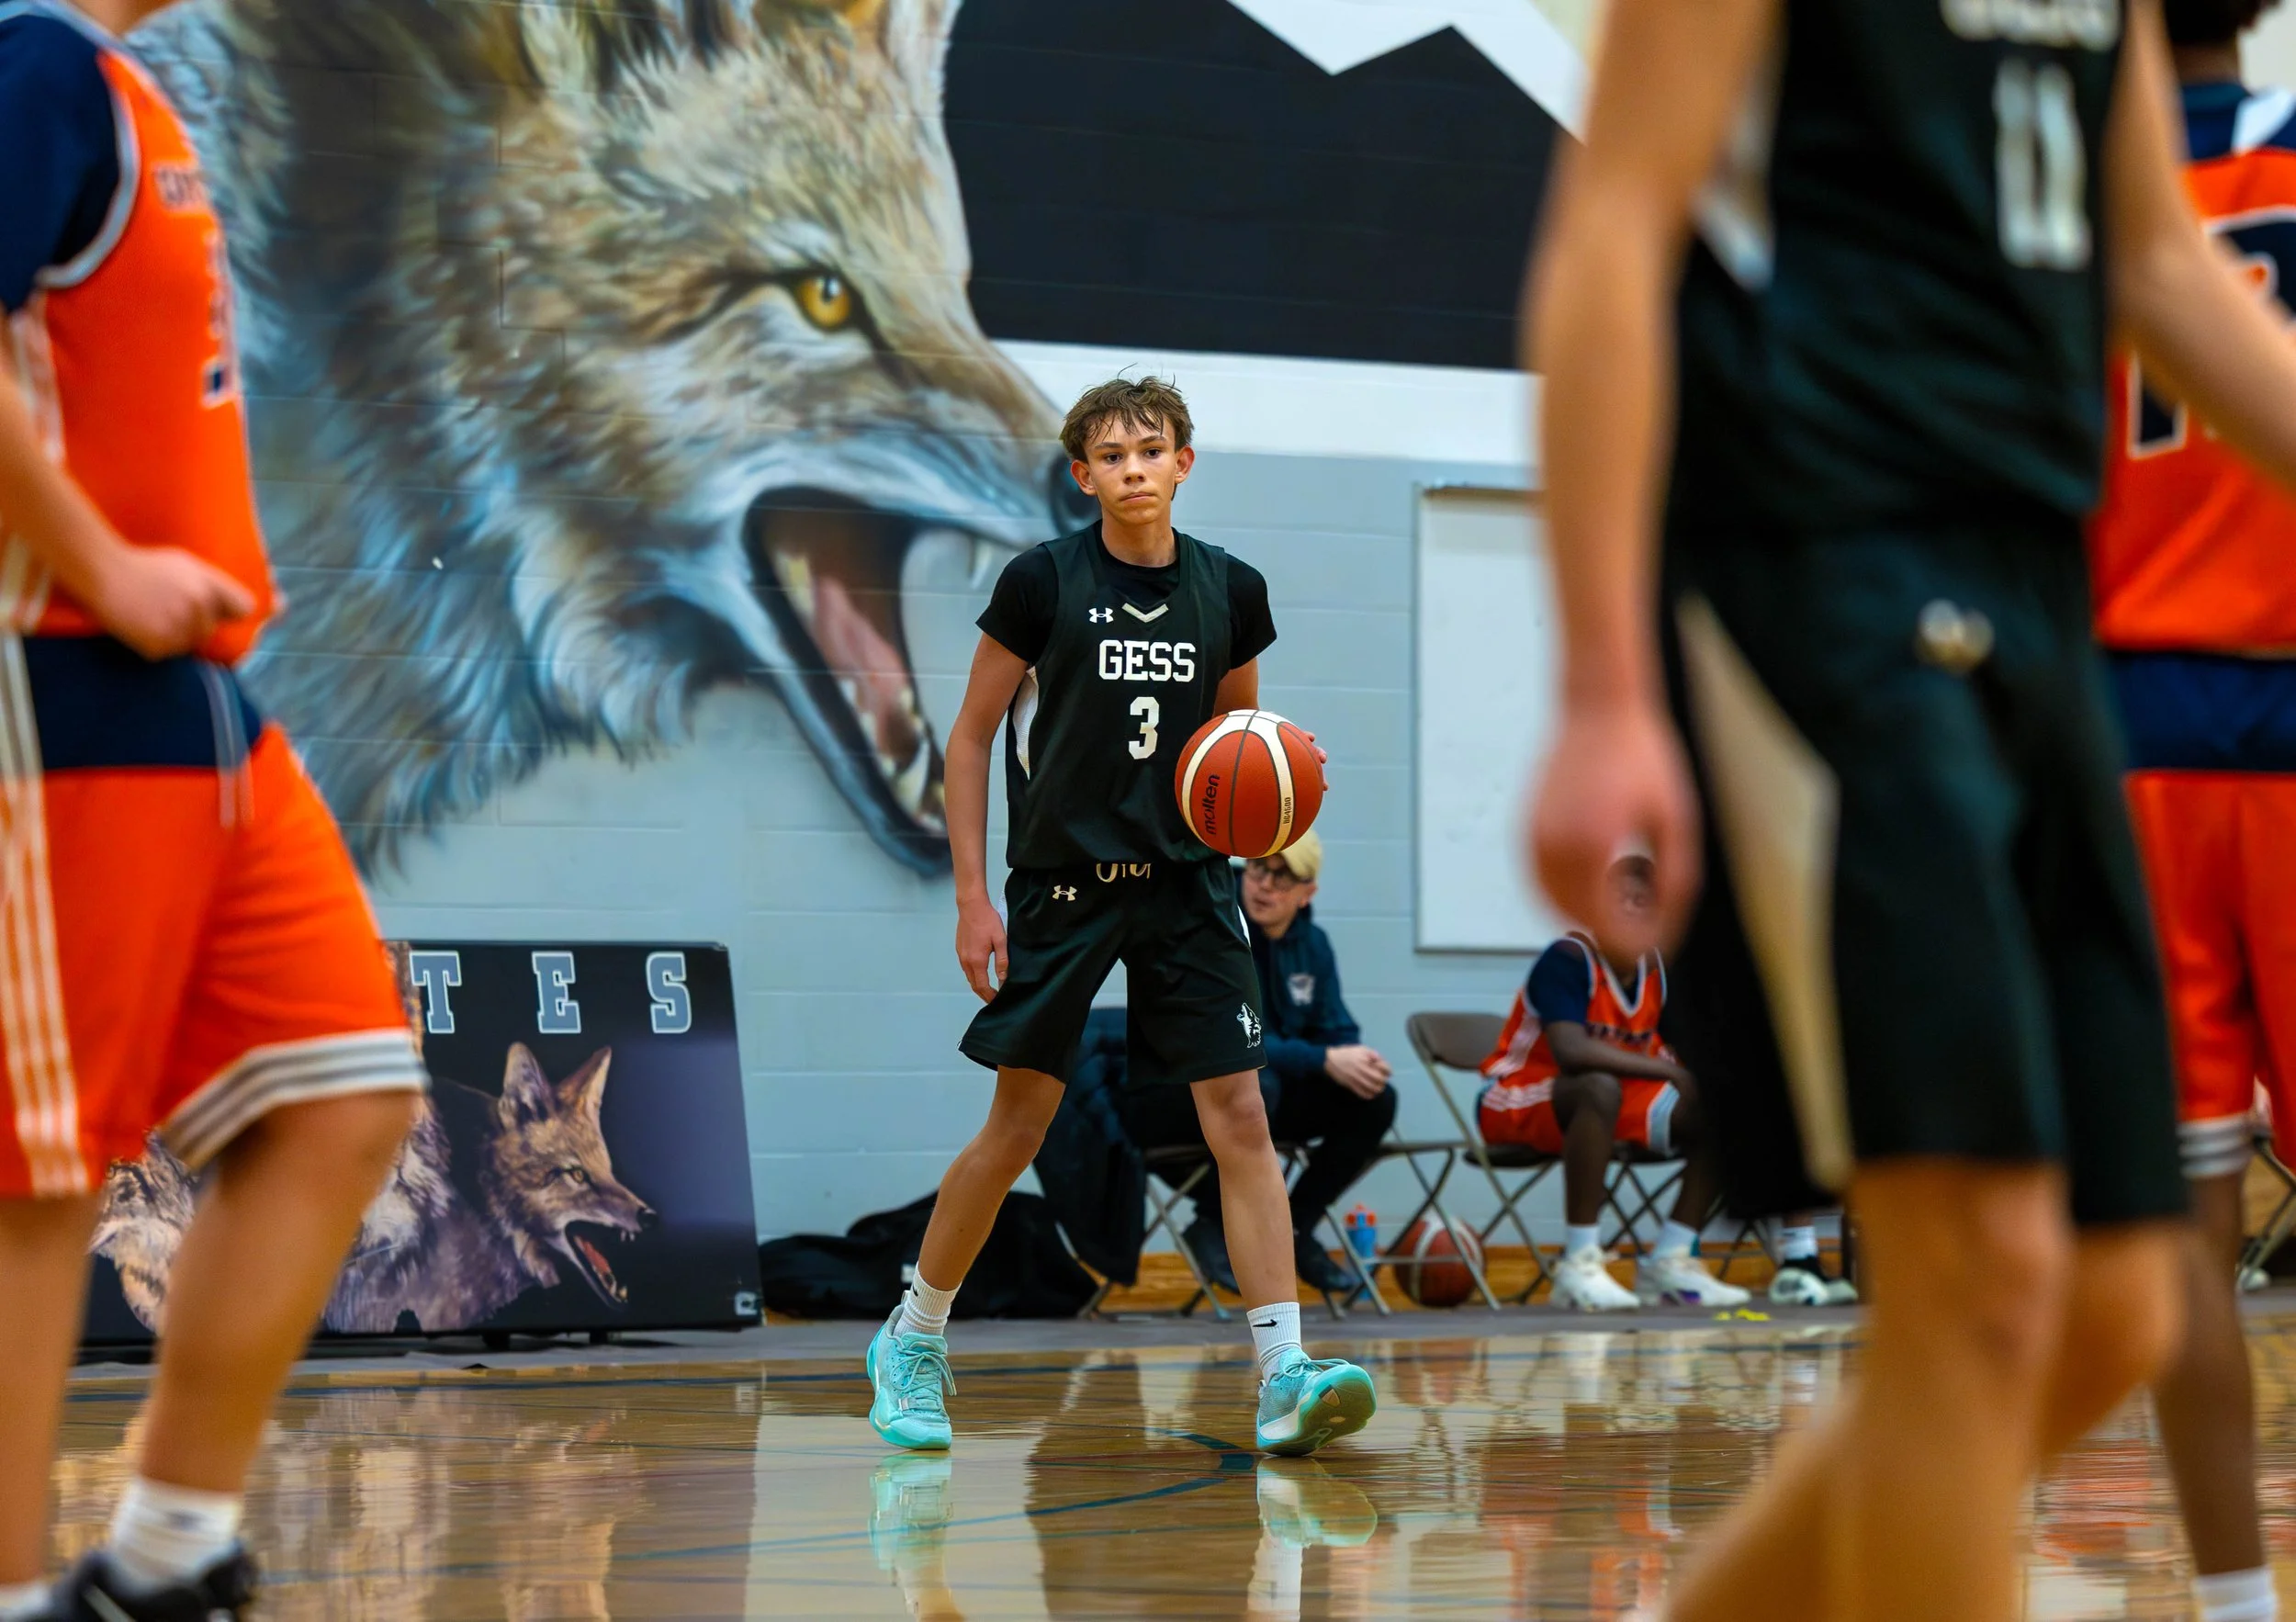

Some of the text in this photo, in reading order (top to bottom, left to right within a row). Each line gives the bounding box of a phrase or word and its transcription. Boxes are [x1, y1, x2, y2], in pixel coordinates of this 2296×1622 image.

[1098, 639, 1197, 682] GESS
[1128, 696, 1160, 760] 3
[1201, 774, 1221, 836] molten
